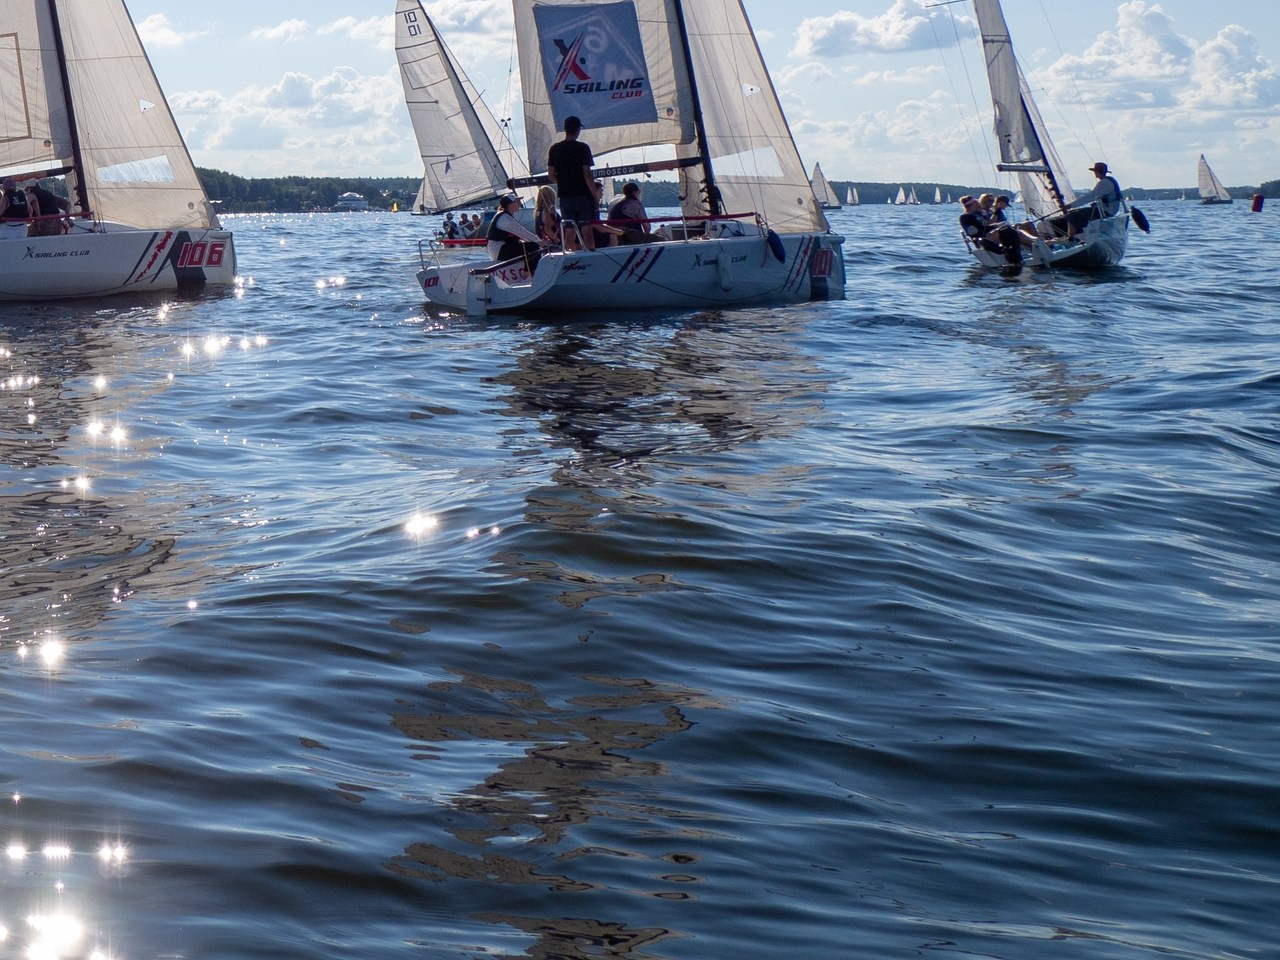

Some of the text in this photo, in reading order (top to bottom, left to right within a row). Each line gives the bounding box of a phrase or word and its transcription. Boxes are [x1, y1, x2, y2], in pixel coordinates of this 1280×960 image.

[563, 77, 644, 95] SAILING
[611, 90, 643, 100] CLUB
[34, 251, 68, 259] SAILING
[69, 249, 90, 257] CLUB
[177, 240, 226, 268] 106
